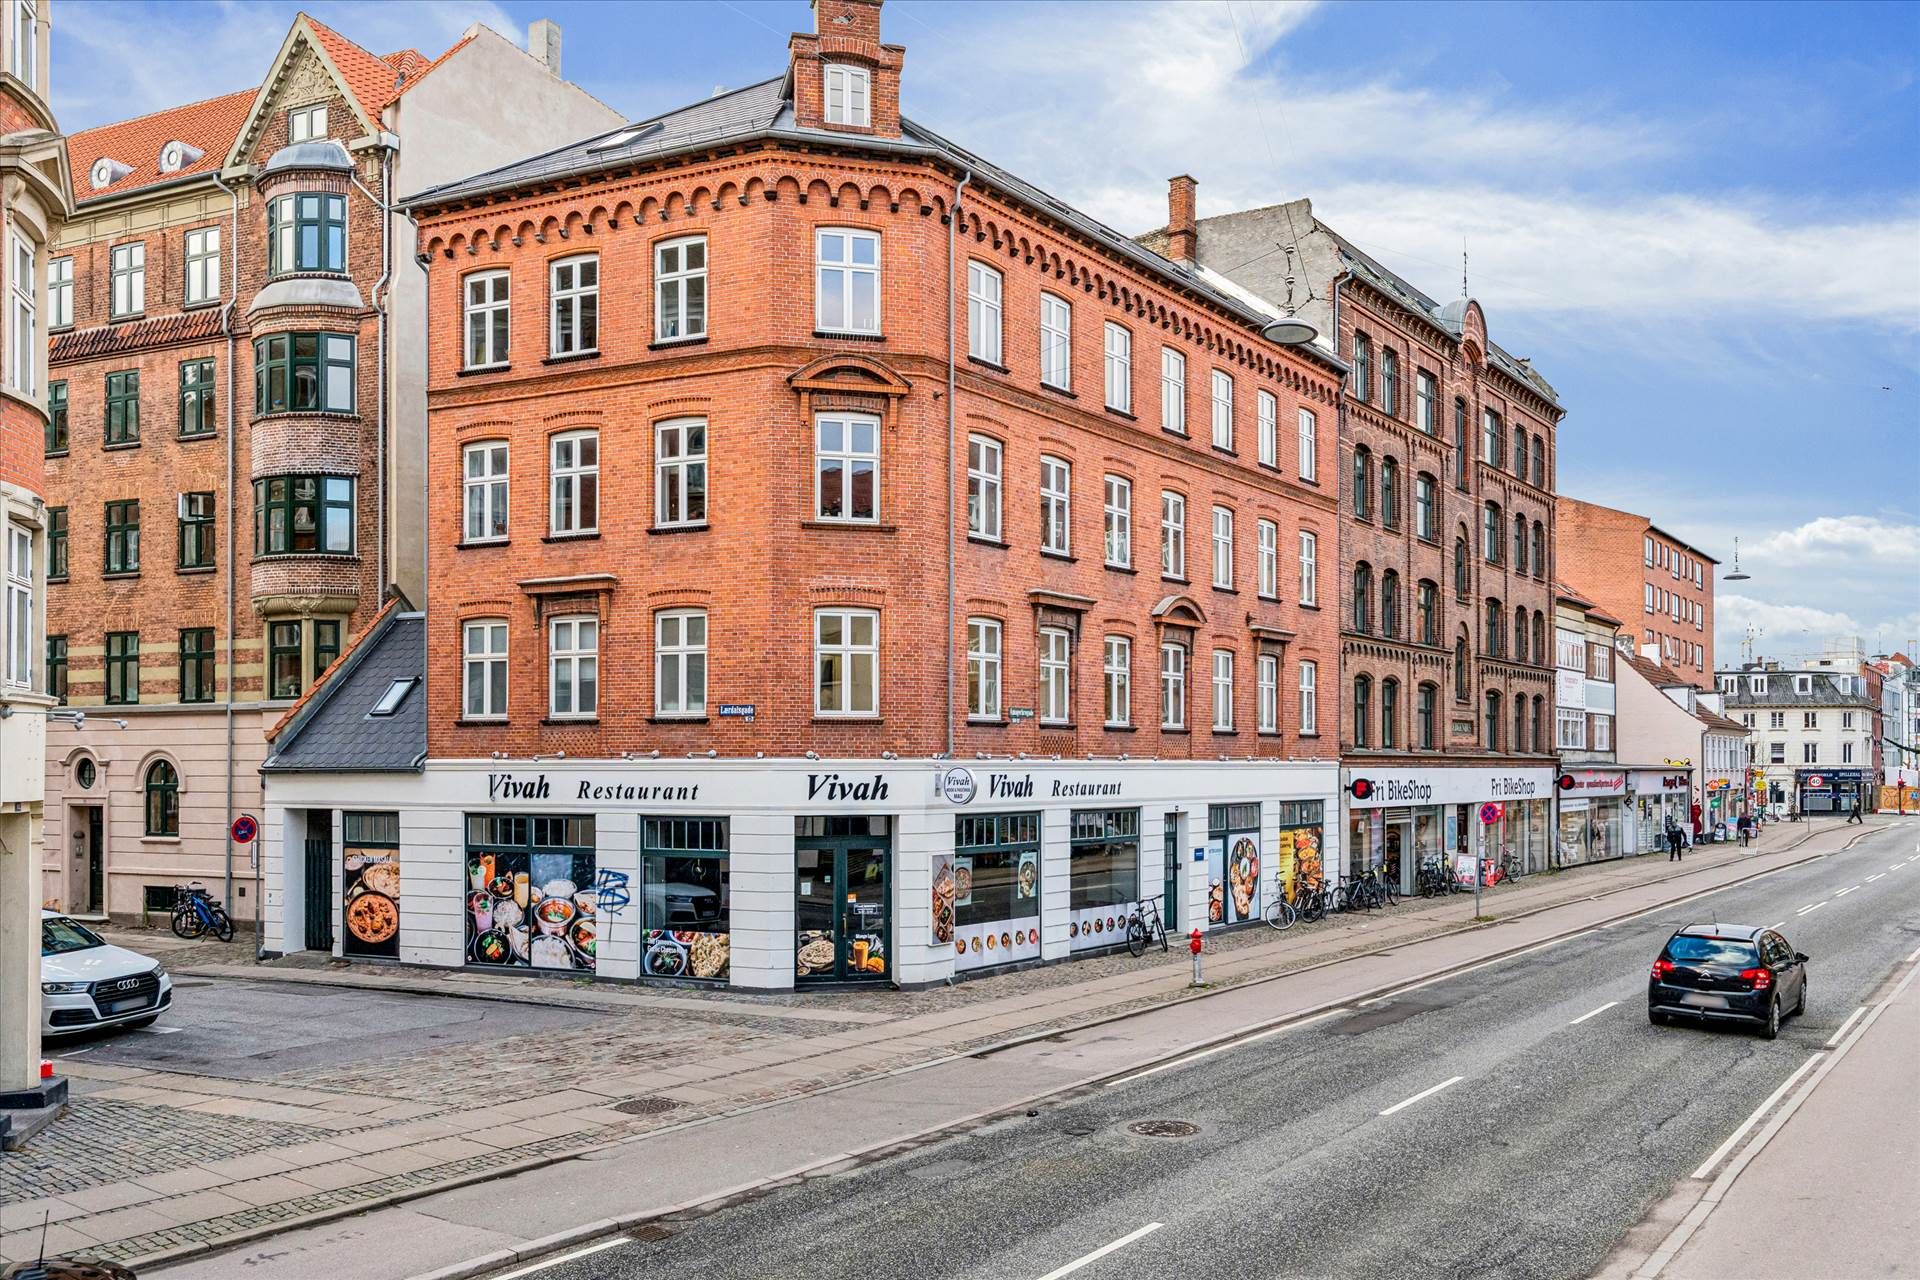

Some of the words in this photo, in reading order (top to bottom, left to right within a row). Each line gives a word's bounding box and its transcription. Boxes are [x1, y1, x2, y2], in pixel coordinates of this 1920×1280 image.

[720, 706, 753, 715] Lærdalsgade
[488, 773, 551, 800] Vivah
[577, 780, 699, 800] Restaurant
[807, 774, 889, 801] Vivah
[948, 776, 969, 786] Vivah
[988, 774, 1034, 798] Vivah
[1052, 780, 1122, 797] Restaurant
[1370, 780, 1385, 801] Fri
[1388, 779, 1432, 804] BikeShop
[1491, 778, 1502, 796] Fri
[1503, 777, 1536, 799] BikeShop
